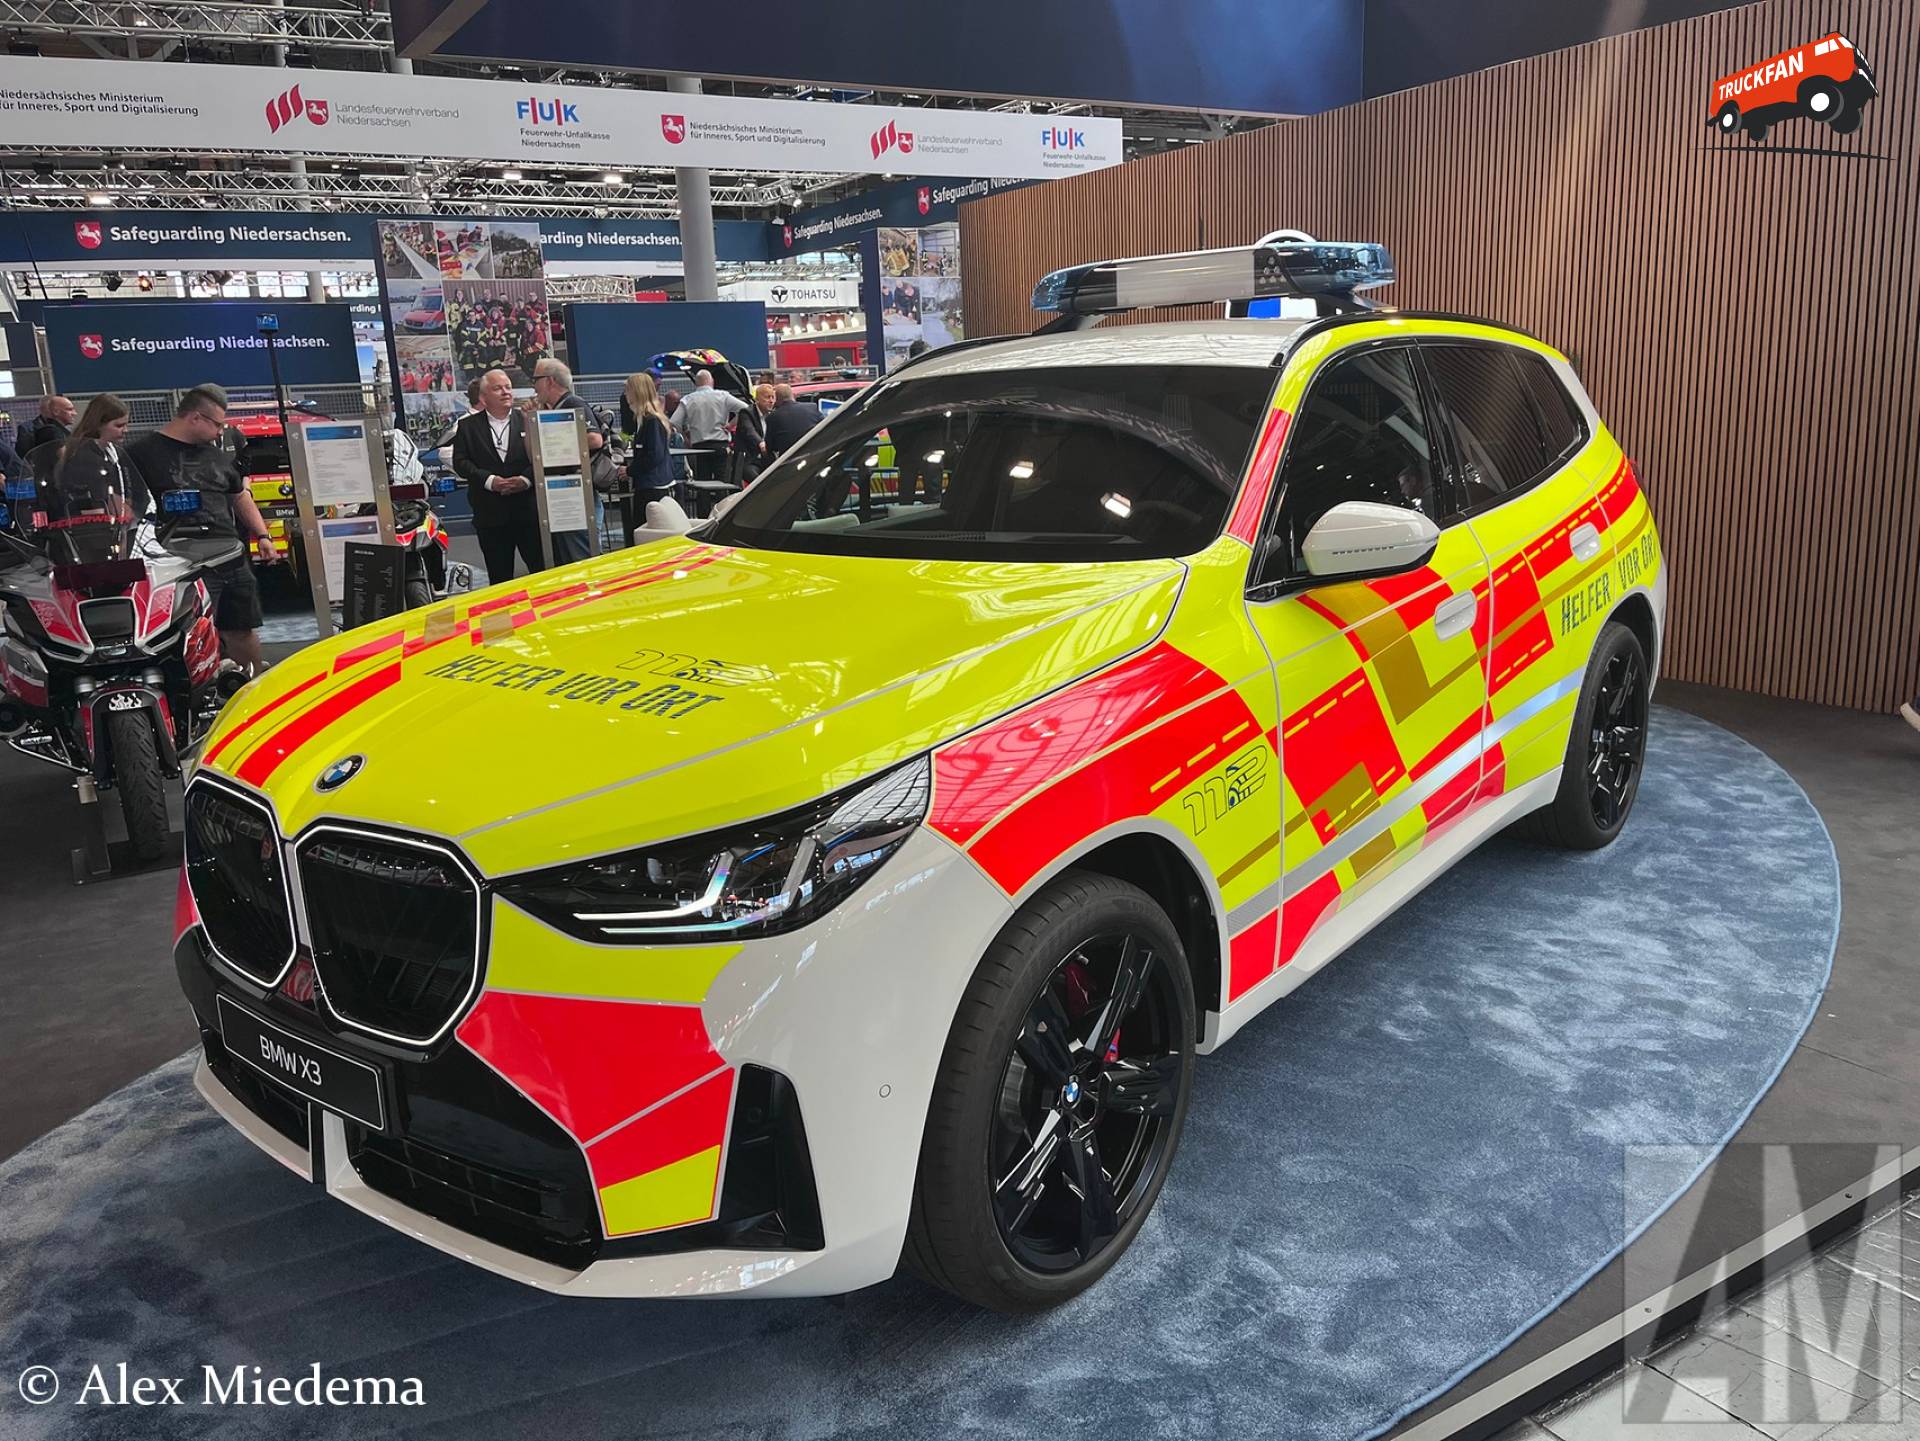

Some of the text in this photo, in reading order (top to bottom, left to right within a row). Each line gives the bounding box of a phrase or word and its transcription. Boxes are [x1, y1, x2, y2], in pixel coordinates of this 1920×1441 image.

[100, 92, 164, 103] Ministerium
[17, 101, 62, 112] Inneres,
[65, 102, 95, 114] Sport
[98, 103, 119, 112] und
[122, 103, 199, 117] Digitalisierung
[334, 102, 459, 118] Landesfeuerwehrverband
[337, 114, 411, 127] Niedersachsen
[690, 122, 802, 135] Niedersächsisches Ministerium
[520, 127, 610, 140] Feuerwehr-Unfallkasse
[690, 131, 701, 139] für
[735, 133, 756, 142] Sport
[757, 134, 772, 142] und
[773, 135, 826, 146] Digitalisierung
[521, 139, 581, 149] Niedersachsen
[918, 145, 968, 154] Niedersachsen
[932, 179, 988, 204] Safeguarding
[794, 208, 883, 239] Safeguarding Niedersachsen.
[110, 226, 351, 244] Safeguarding Niedersachsen.
[587, 232, 682, 246] Niedersachsen.
[791, 289, 836, 299] TOHATSU
[111, 336, 215, 353] Safeguarding
[275, 509, 295, 517] BMW
[1561, 572, 1611, 637] HELFER
[1618, 546, 1642, 591] VOR
[616, 649, 775, 688] 112
[424, 654, 725, 719] HELFER VOR ORT
[1182, 744, 1268, 837] 112
[259, 1034, 322, 1086] BMW X3
